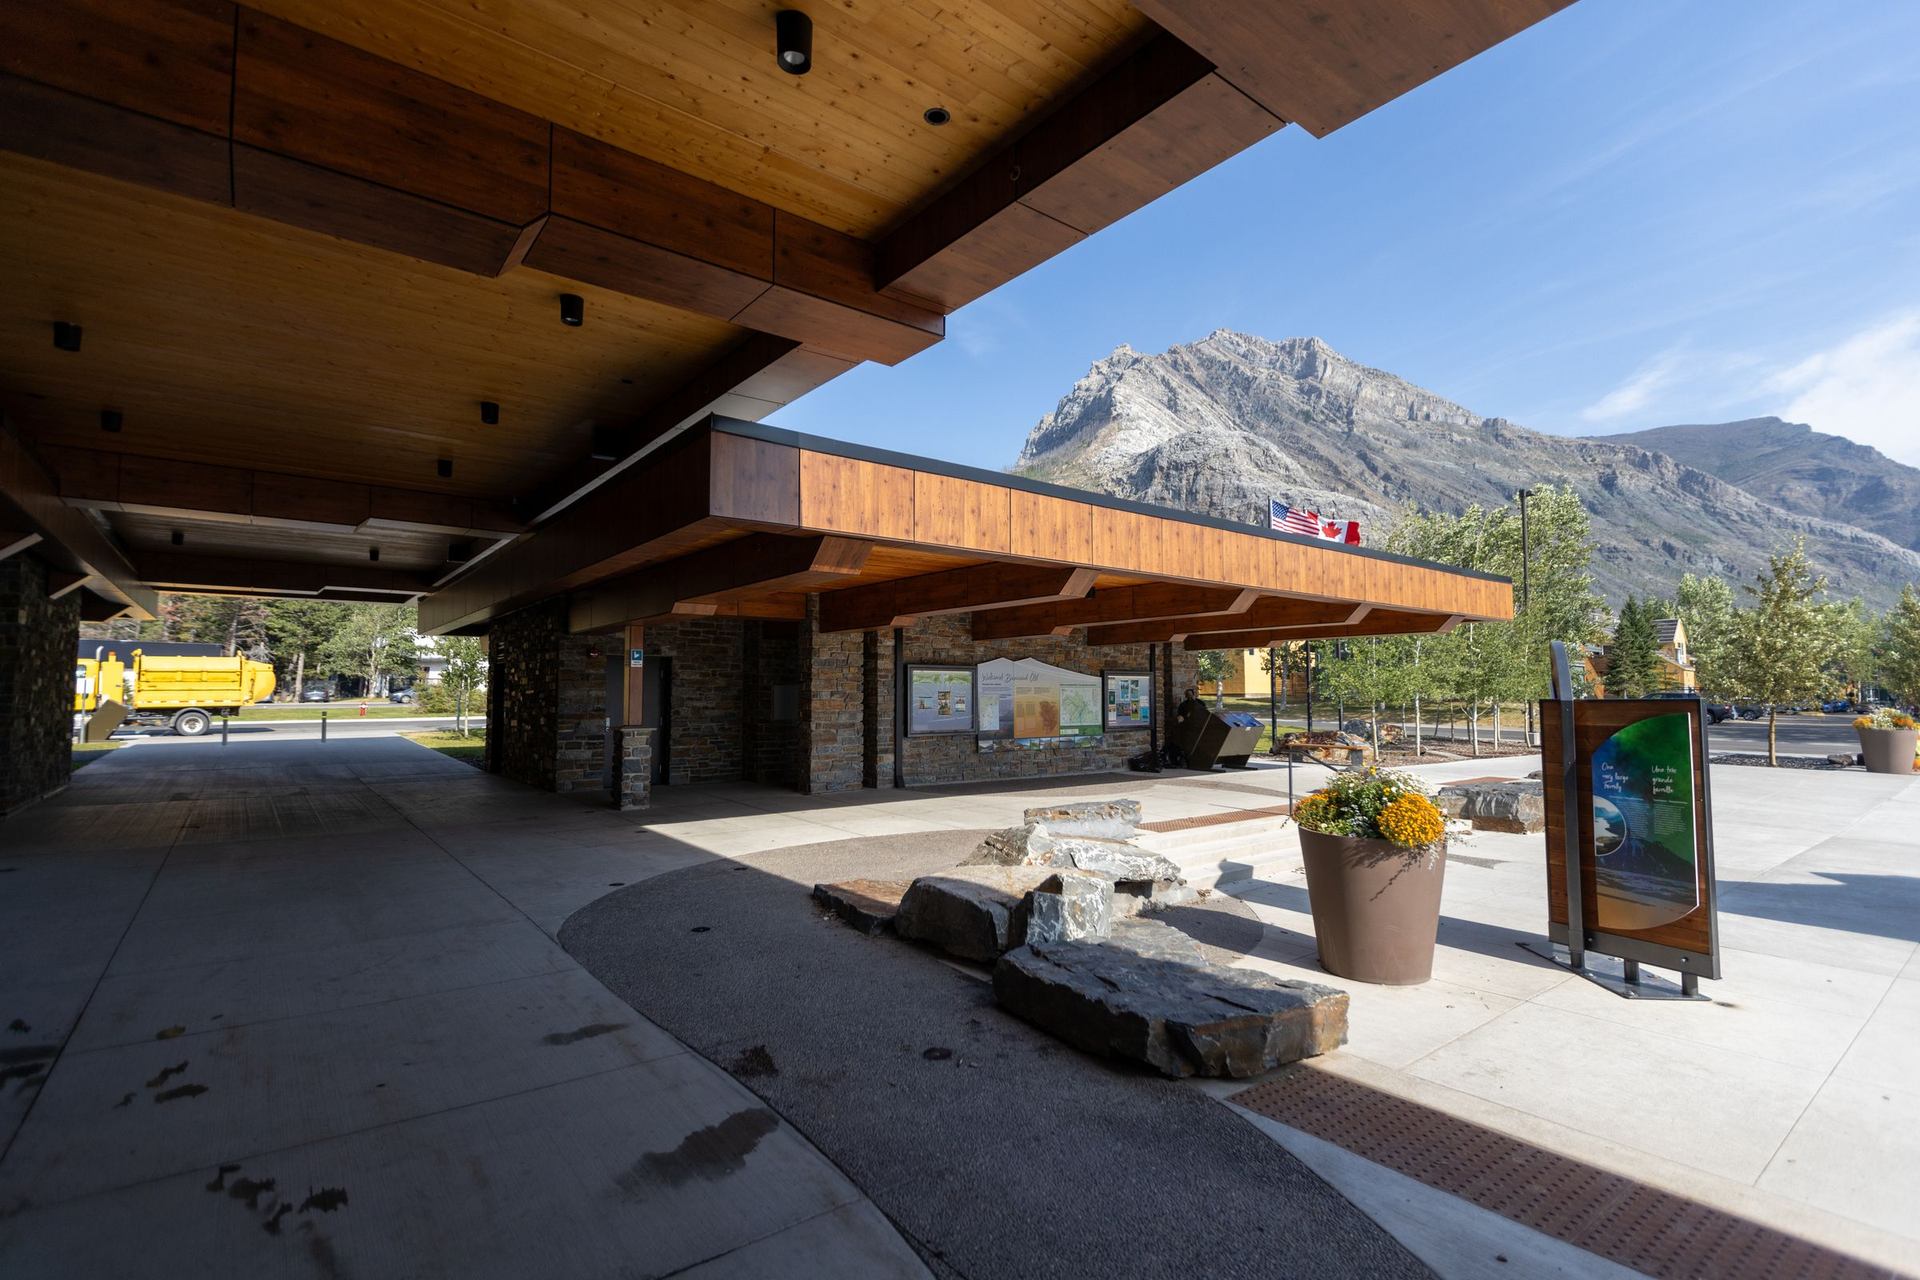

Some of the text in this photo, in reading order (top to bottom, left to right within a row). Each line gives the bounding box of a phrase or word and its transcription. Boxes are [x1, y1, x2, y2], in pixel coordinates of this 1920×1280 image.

[1601, 761, 1614, 772] One
[1651, 764, 1665, 774] Une
[1614, 771, 1629, 784] large
[1652, 776, 1674, 786] grande
[1652, 785, 1675, 795] famille
